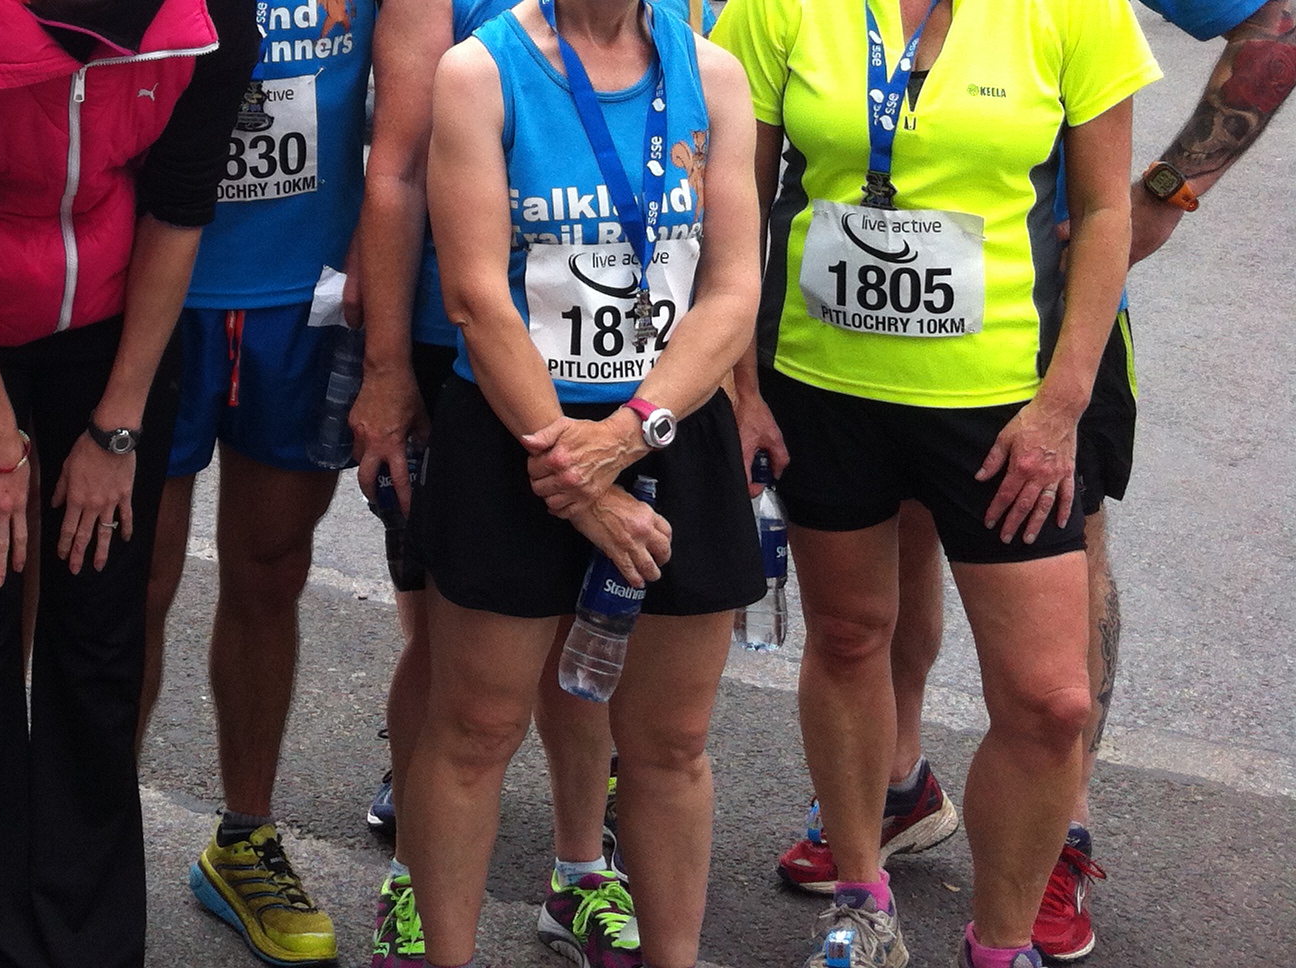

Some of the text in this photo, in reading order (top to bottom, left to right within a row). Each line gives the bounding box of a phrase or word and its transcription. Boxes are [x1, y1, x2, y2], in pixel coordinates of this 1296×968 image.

[872, 45, 882, 66] sse
[885, 93, 899, 115] sse
[651, 136, 663, 160] sse
[274, 175, 315, 196] 10KM
[647, 201, 659, 225] sse
[861, 214, 942, 233] live active
[592, 252, 616, 268] live
[828, 260, 955, 316] 1805
[821, 304, 966, 334] PITLOCHRY 10KM
[548, 358, 644, 379] PITLOCHRY
